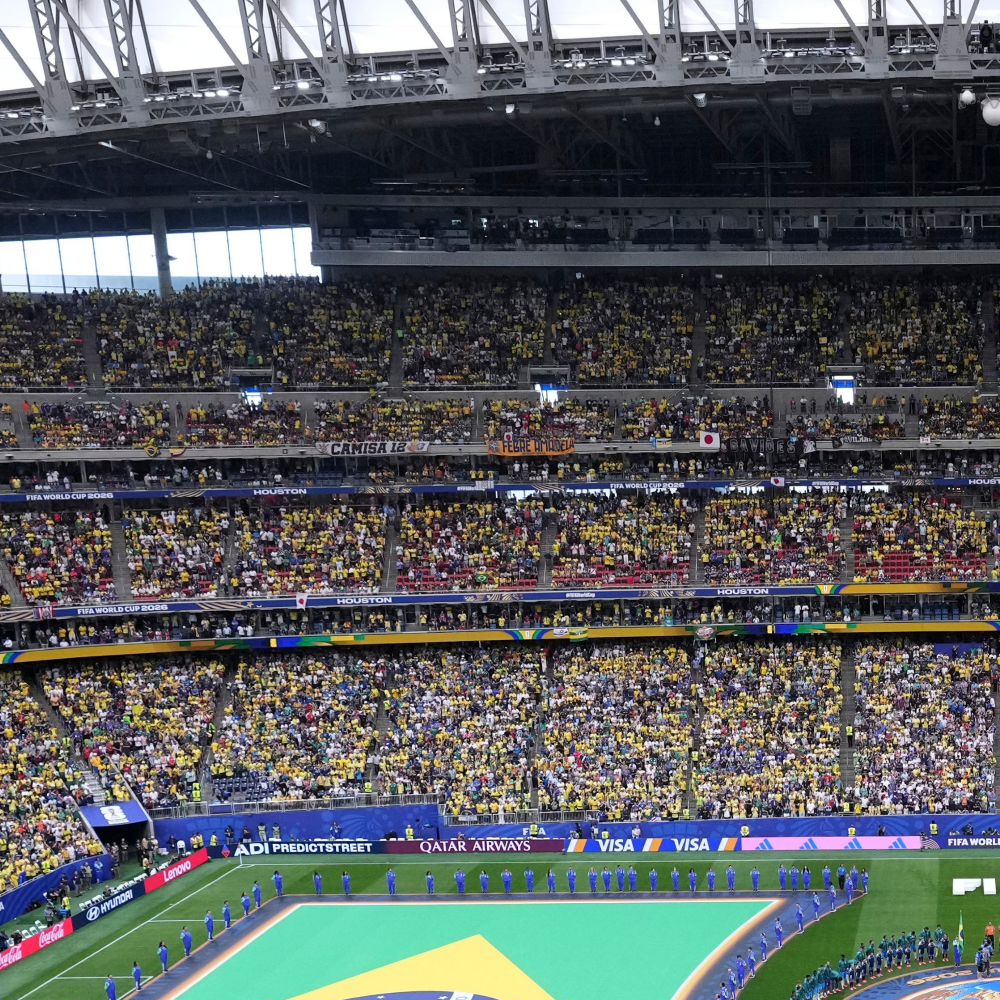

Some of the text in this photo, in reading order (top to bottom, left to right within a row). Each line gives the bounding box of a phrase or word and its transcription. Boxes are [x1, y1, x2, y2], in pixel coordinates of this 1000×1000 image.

[330, 442, 406, 455] CAMISA 12
[502, 440, 531, 452] FEBRE
[420, 841, 530, 853] QATAR AIRWAYS
[598, 838, 634, 851] VISA
[673, 838, 709, 851] VISA
[948, 838, 968, 846] FIFA
[234, 843, 372, 856] ADI PREDICTSTREET
[164, 860, 191, 882] Lenovo
[100, 890, 133, 914] HYUNDAI
[38, 921, 64, 947] Coca-Cola
[907, 970, 973, 986] 2026
